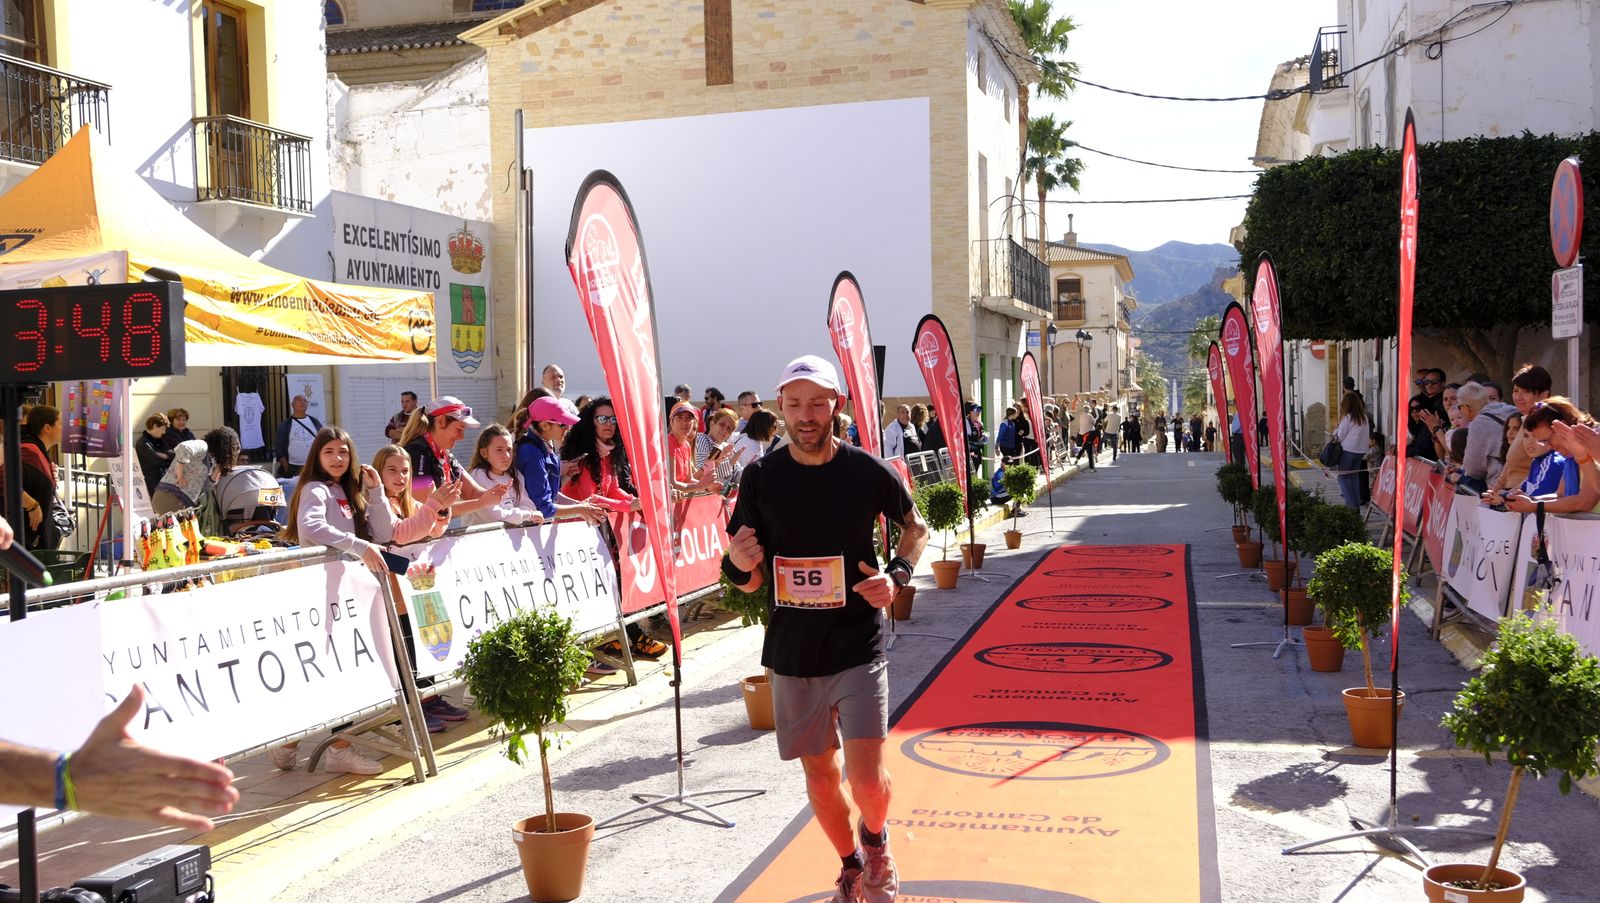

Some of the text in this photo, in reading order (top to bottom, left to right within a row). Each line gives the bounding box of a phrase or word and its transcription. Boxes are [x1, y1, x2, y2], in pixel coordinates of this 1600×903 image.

[343, 223, 441, 259] EXCELENTÍSIMO
[346, 258, 441, 289] AYUNTAMIENTO
[13, 292, 163, 371] 3:48
[672, 522, 725, 567] EOLIA
[454, 547, 598, 587] AYUNTAMIENTO DE
[792, 570, 823, 586] 56
[459, 567, 608, 629] CANTORIA
[103, 598, 358, 675] YUNTAMIENTO DE
[105, 628, 375, 730] ANTORIA
[990, 688, 1090, 697] Cantoria
[972, 693, 1140, 704] Ayuntamiento
[885, 817, 1121, 838] Ayuntamiento
[910, 807, 1103, 825] de Cantoria
